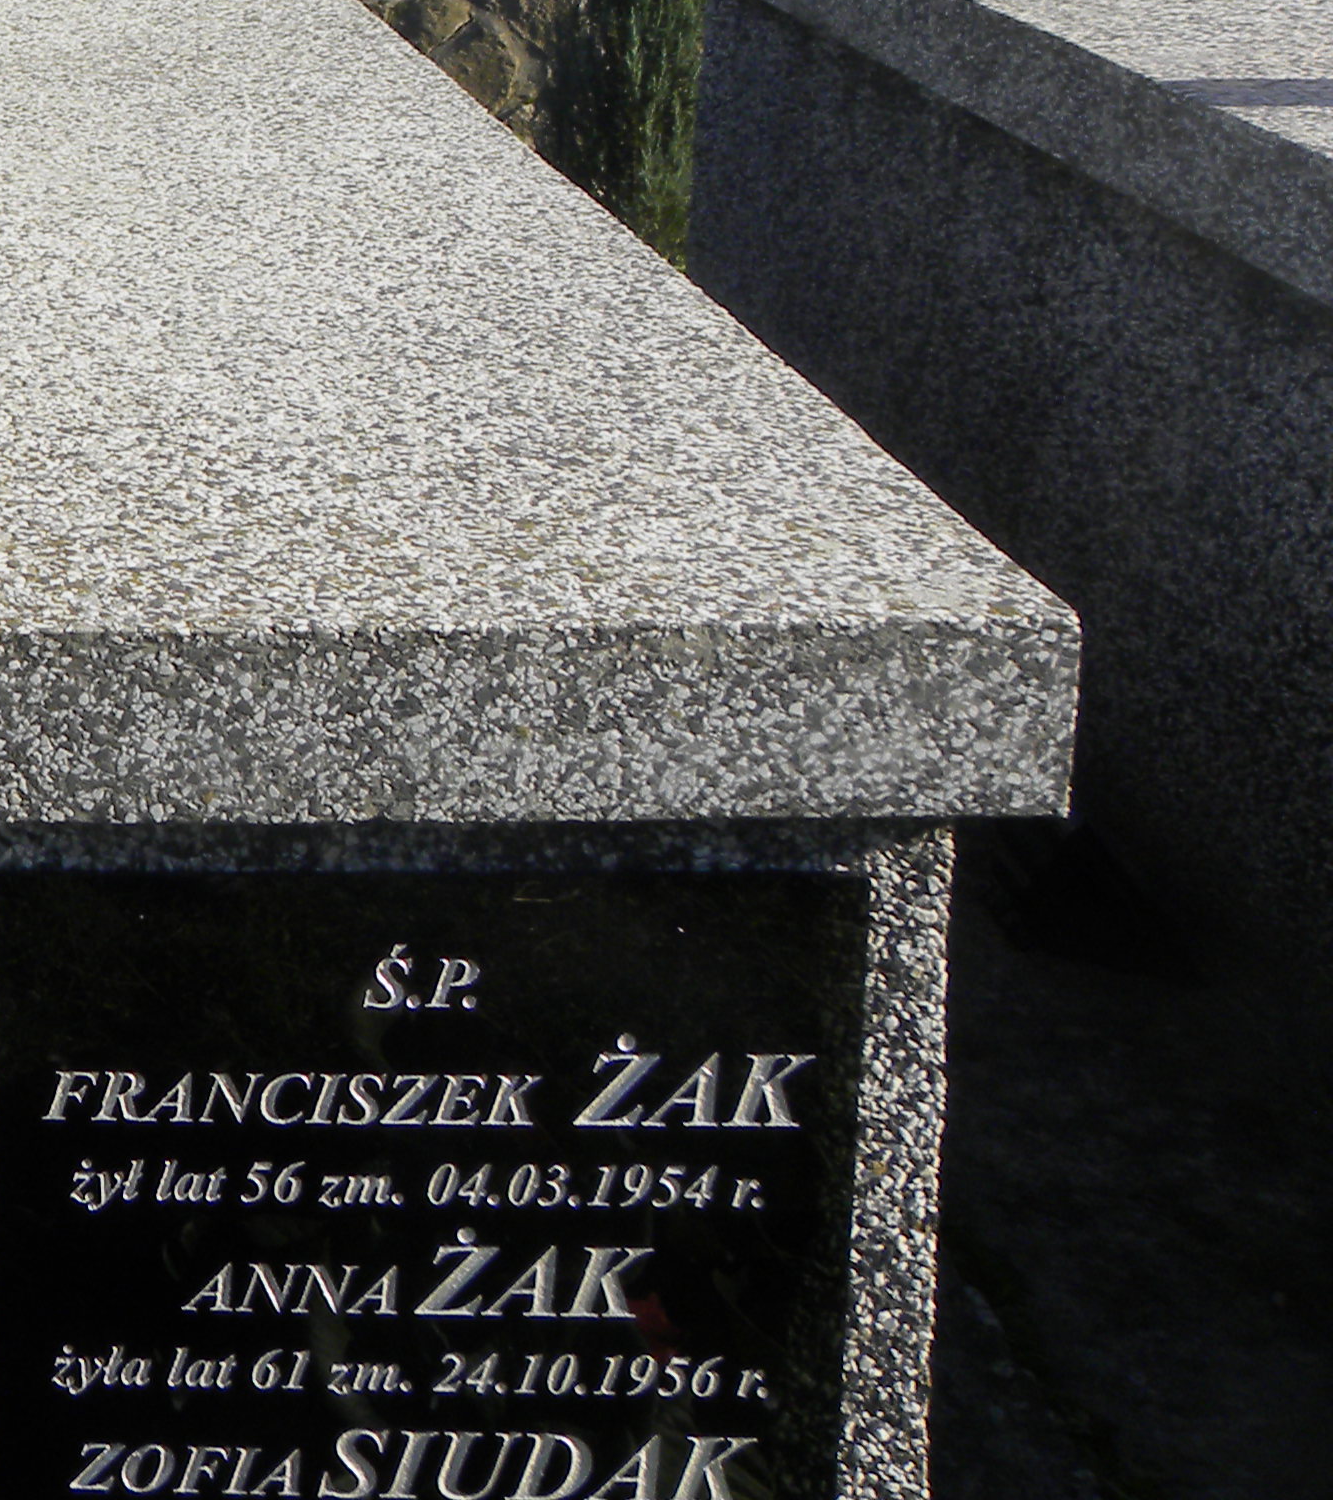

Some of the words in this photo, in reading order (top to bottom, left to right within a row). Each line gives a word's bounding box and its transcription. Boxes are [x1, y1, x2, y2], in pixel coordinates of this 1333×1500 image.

[363, 943, 481, 1010] Ś.P.
[41, 1070, 543, 1127] FRANCISZEK
[572, 1032, 817, 1129] ŻAK
[69, 1159, 145, 1212] żył
[155, 1160, 228, 1204] lat
[239, 1160, 306, 1205] 56
[317, 1175, 404, 1209] zm.
[426, 1162, 719, 1209] 04.03.1954
[731, 1178, 764, 1209] r.
[180, 1262, 399, 1316] ANNA
[413, 1227, 656, 1319] ŻAK
[51, 1344, 152, 1396] żyła
[166, 1347, 237, 1390] lat
[251, 1347, 310, 1391] 61
[326, 1363, 412, 1396] zm.
[432, 1352, 723, 1399] 24.10.1956
[736, 1369, 769, 1400] r.
[69, 1442, 302, 1498] ZOFIA
[316, 1427, 759, 1500] SIUDAK
